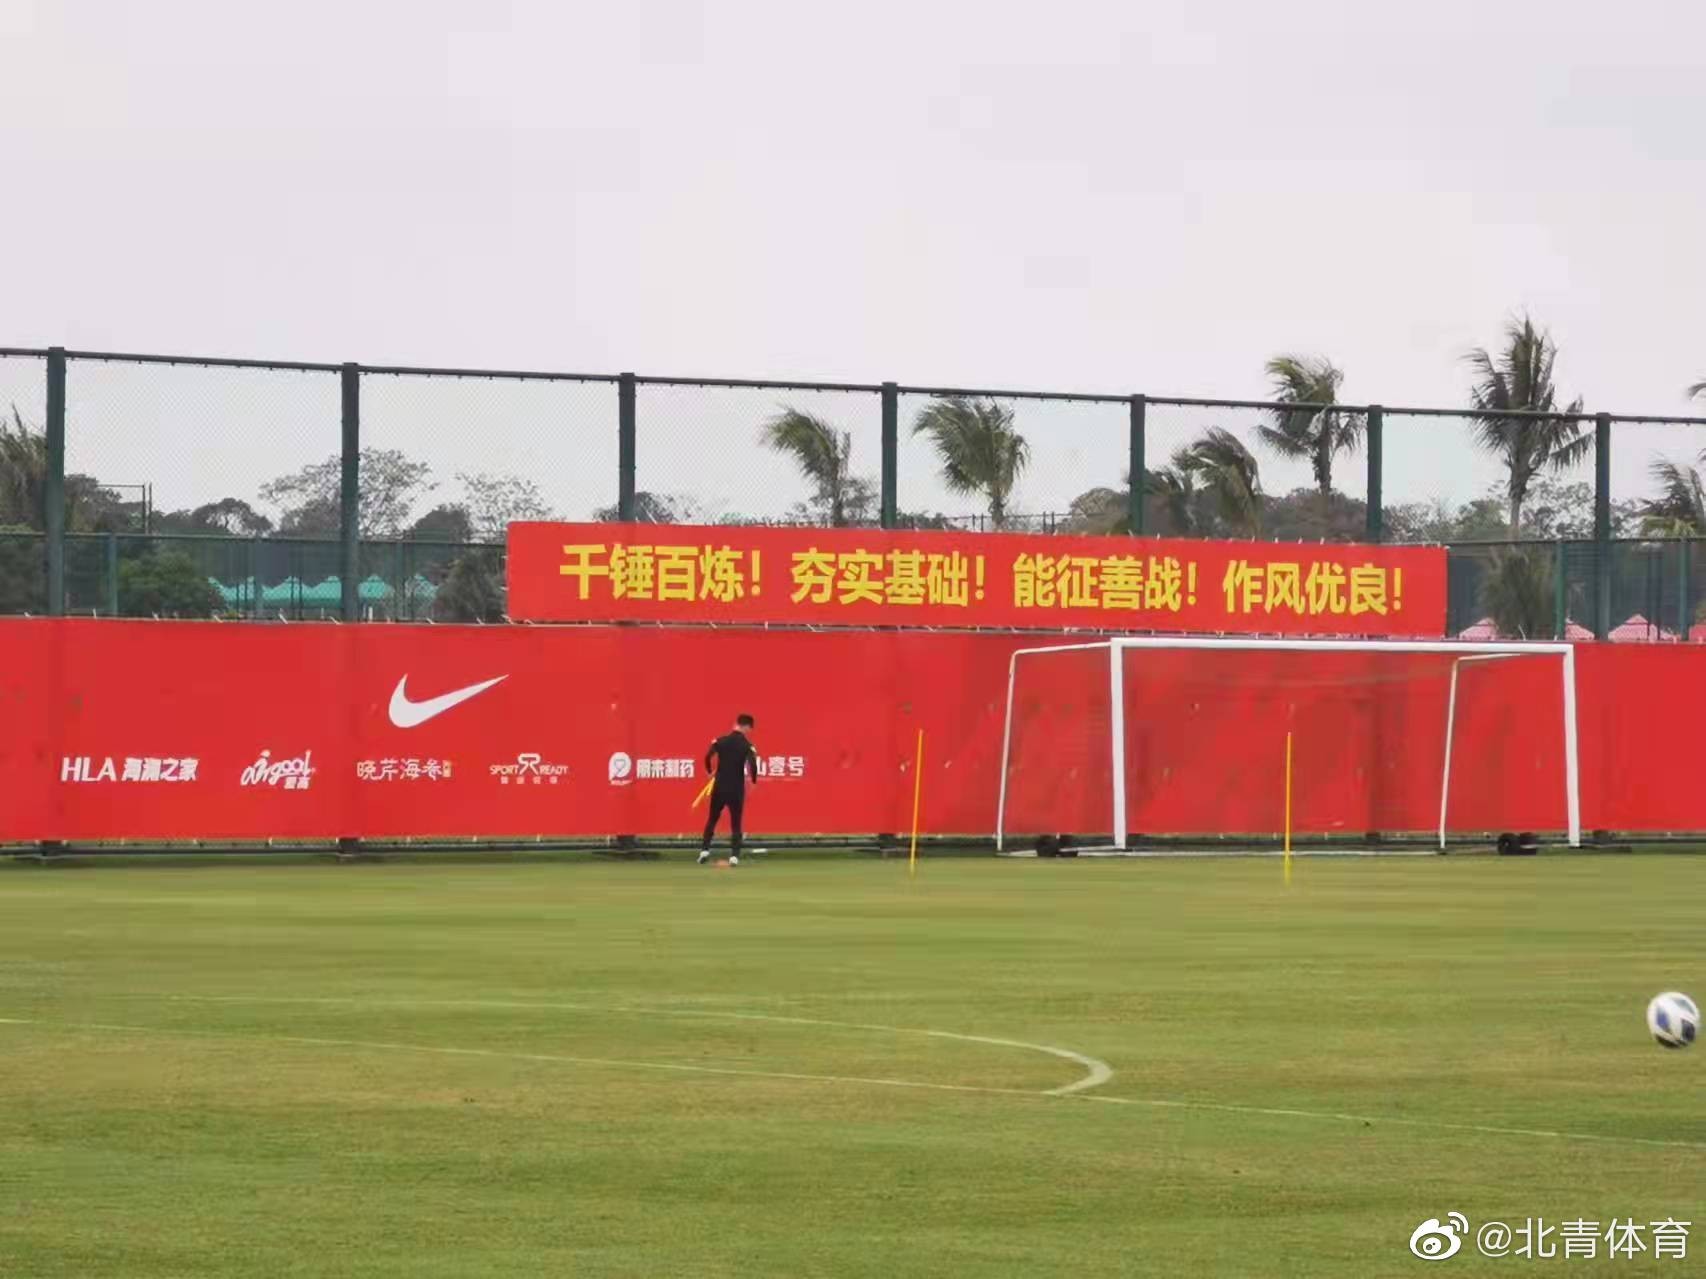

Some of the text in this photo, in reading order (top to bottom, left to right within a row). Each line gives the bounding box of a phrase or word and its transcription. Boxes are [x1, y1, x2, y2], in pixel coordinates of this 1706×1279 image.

[560, 543, 1404, 616] 千锤百炼！ 夯实基础！ 能征善战！ 作风优良！
[61, 757, 118, 782] HLA
